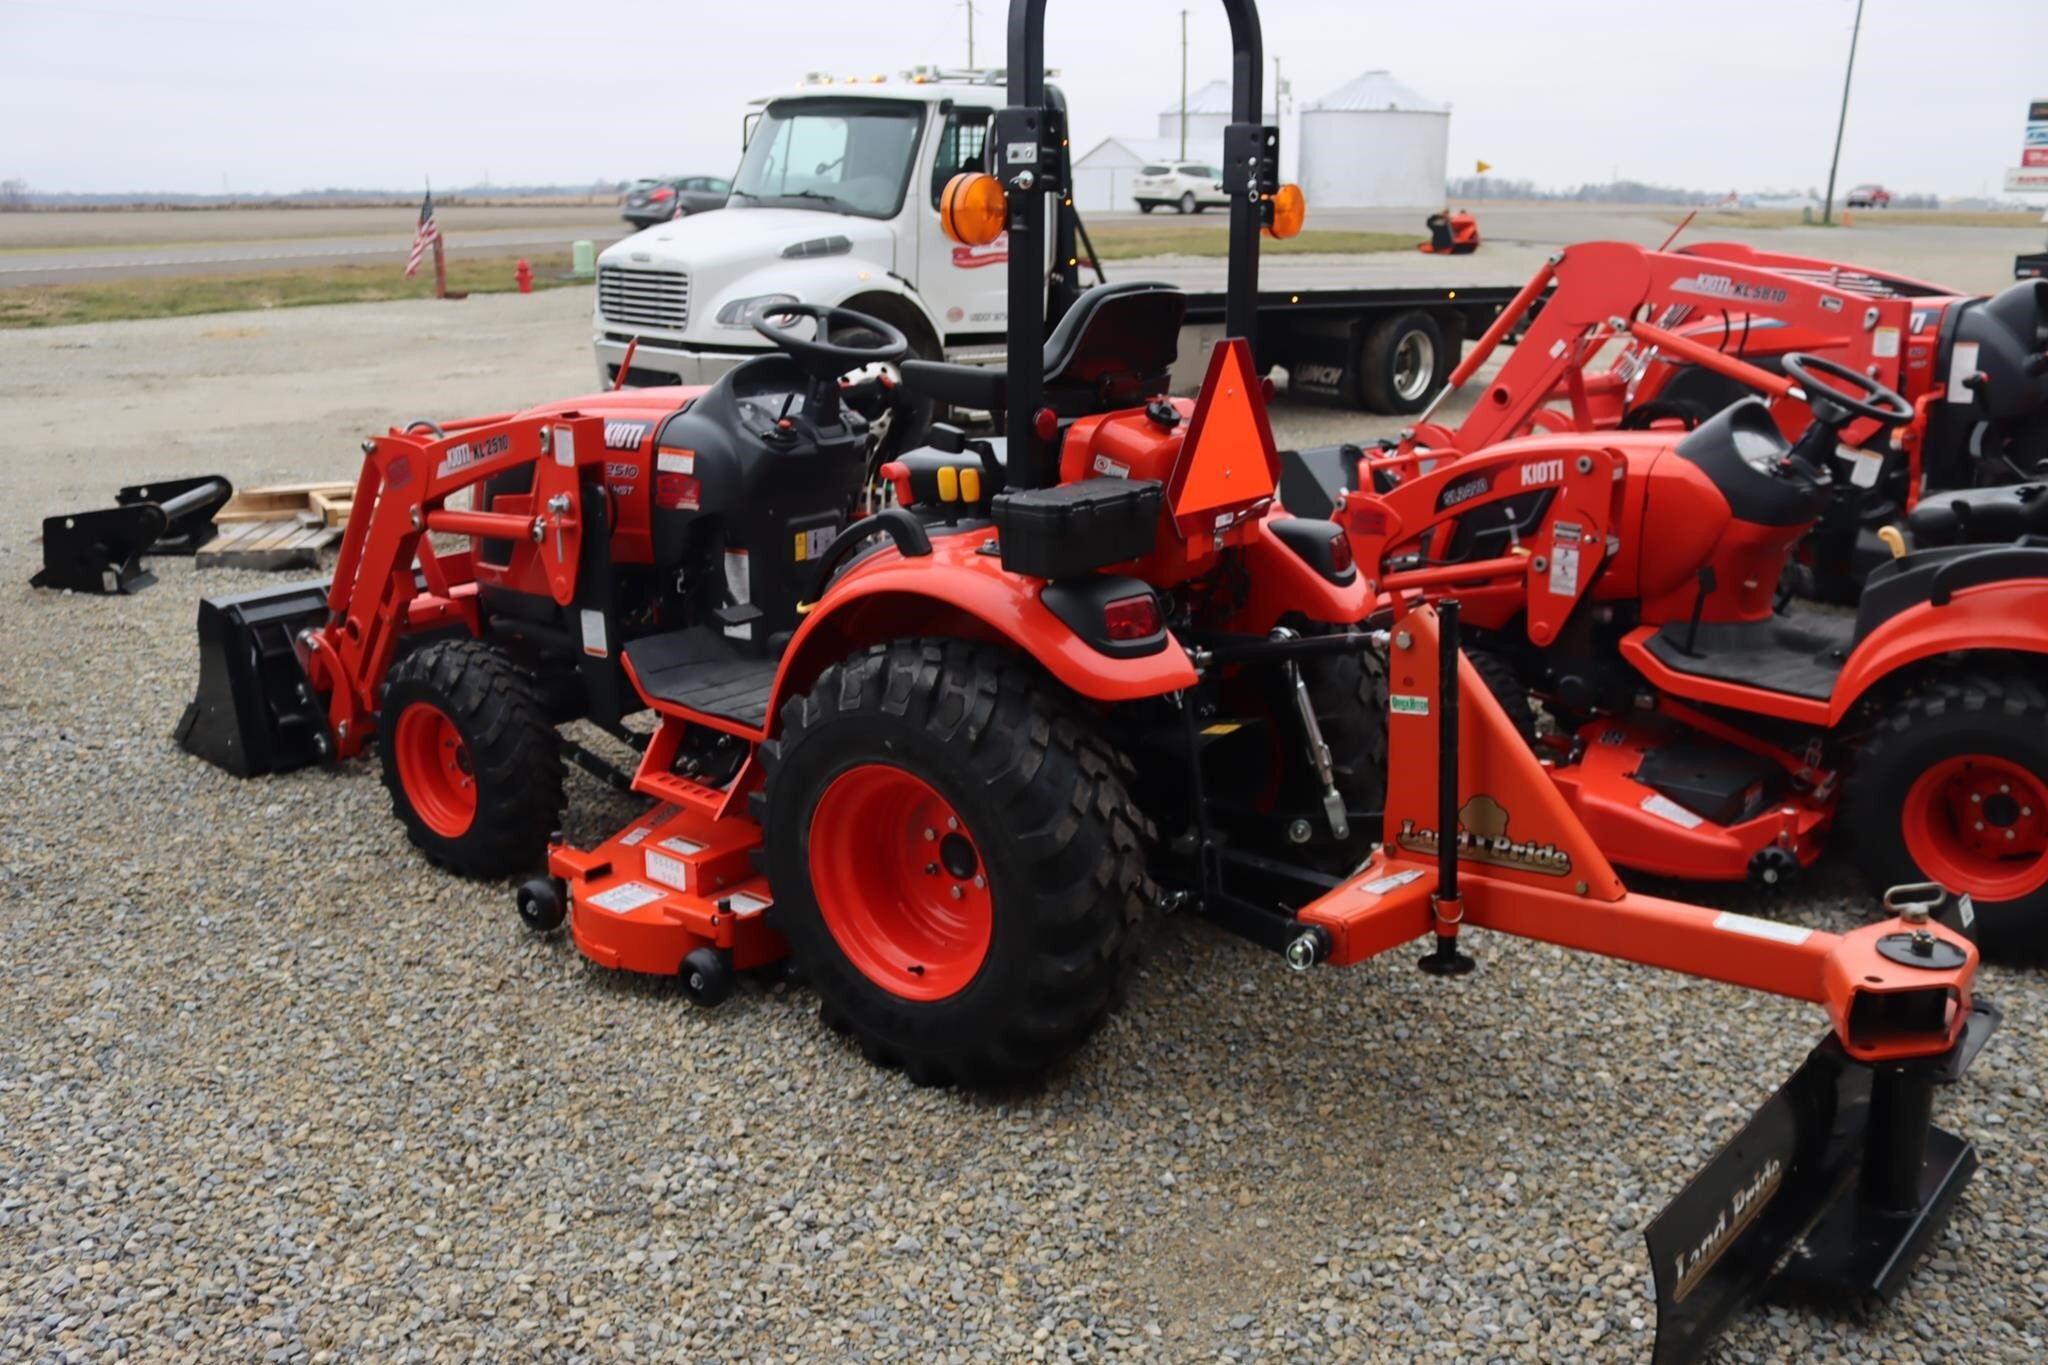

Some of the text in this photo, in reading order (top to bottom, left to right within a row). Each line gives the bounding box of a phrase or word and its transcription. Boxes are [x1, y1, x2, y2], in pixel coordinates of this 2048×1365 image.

[486, 434, 508, 456] 2510
[604, 422, 645, 450] KIOTI
[1520, 459, 1564, 487] KIOTI
